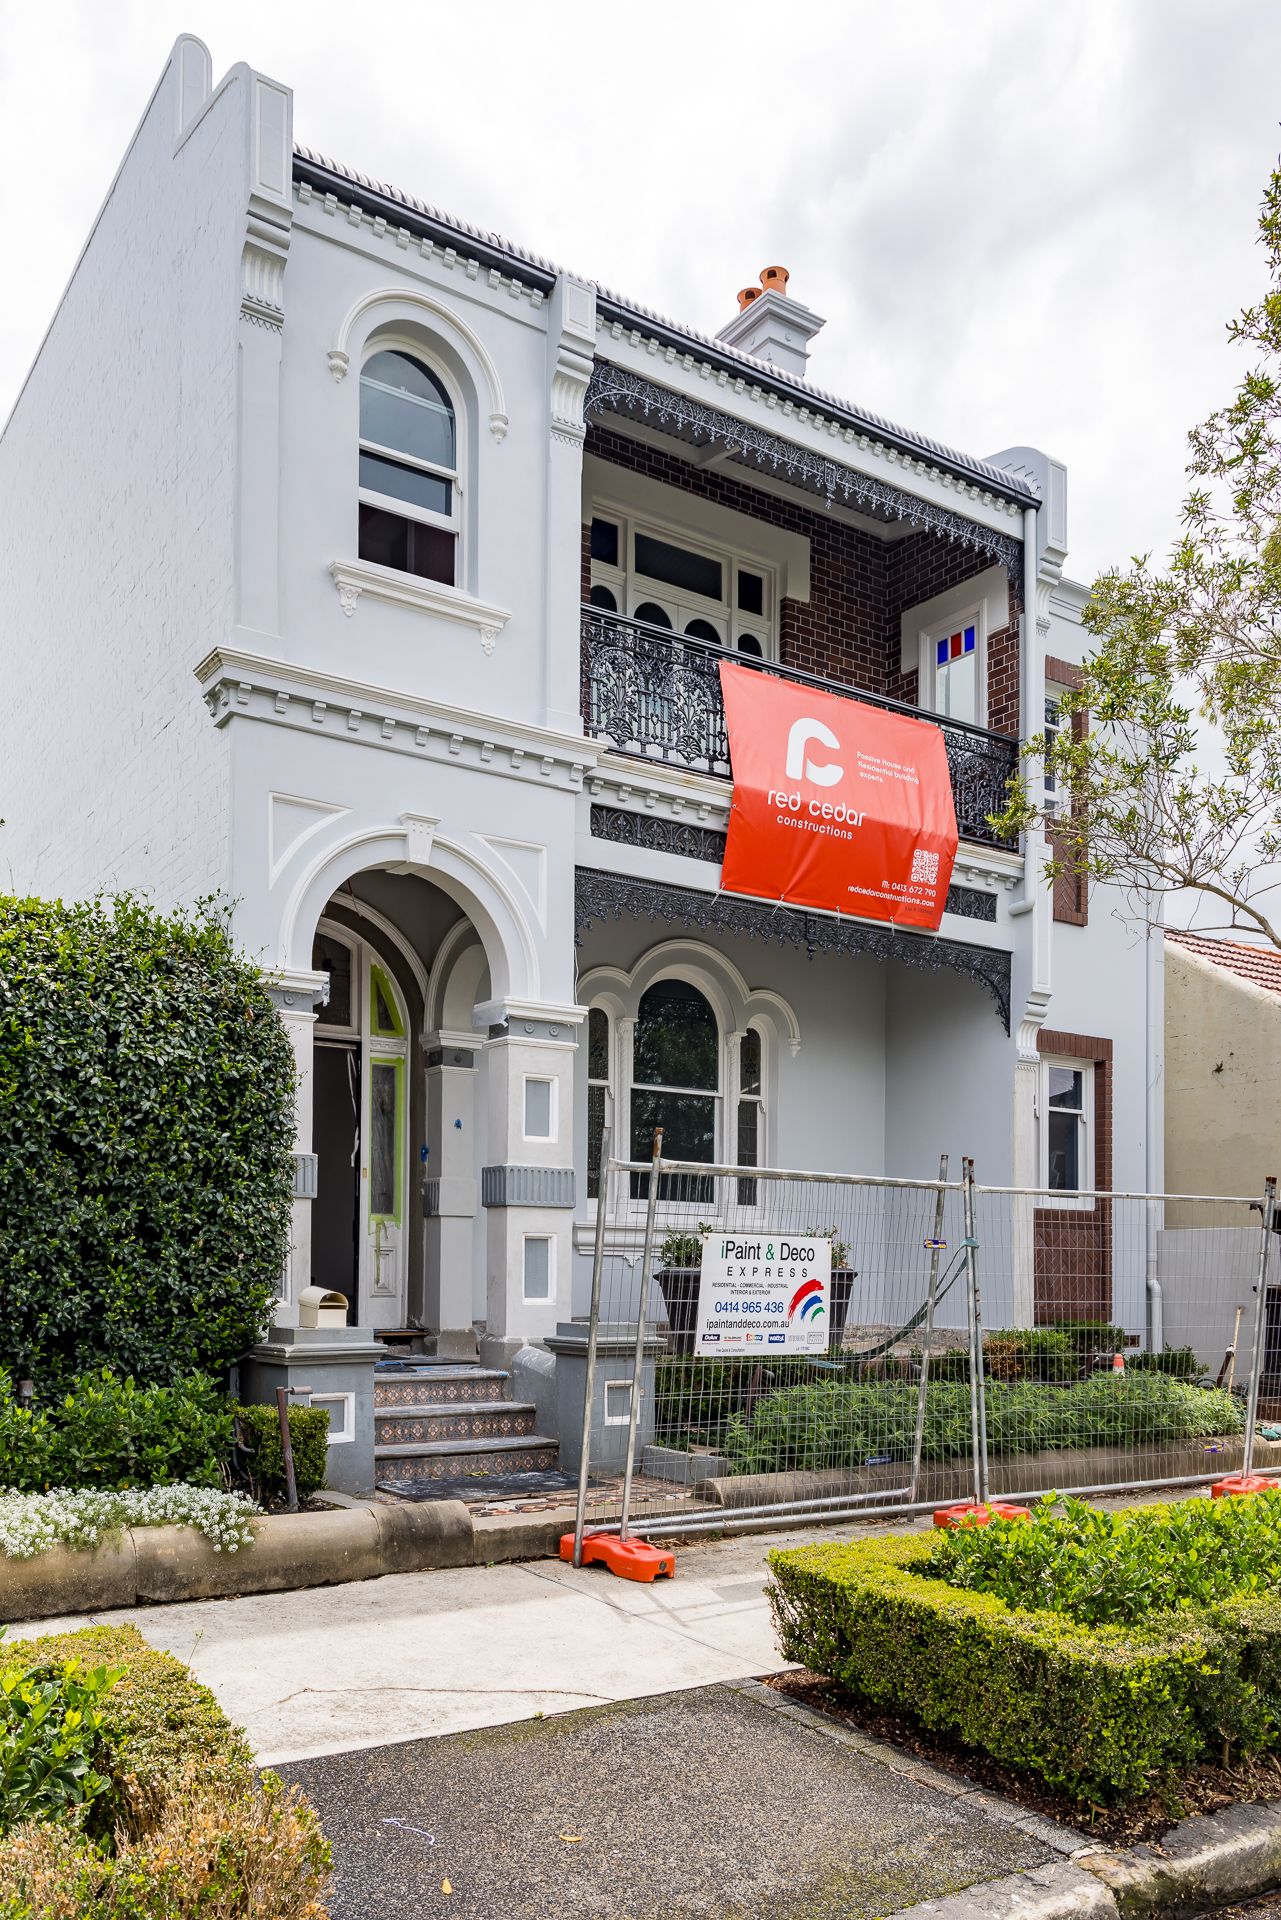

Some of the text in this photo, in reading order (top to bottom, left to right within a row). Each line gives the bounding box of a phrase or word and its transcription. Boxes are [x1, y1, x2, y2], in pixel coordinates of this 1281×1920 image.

[856, 751, 915, 773] Passive House and
[857, 760, 920, 785] Residential building
[859, 771, 884, 783] experts
[767, 788, 866, 827] red cedar
[776, 815, 853, 840] constructions
[847, 885, 935, 907] redcedarconstructions.com
[891, 883, 907, 892] 0413
[909, 886, 923, 895] 672
[924, 888, 936, 897] 790
[721, 1240, 815, 1262] iPaint & Deco
[727, 1266, 808, 1278] EXPRESS
[715, 1301, 784, 1313] 0414 965 436
[706, 1318, 790, 1331] ipaintanddeco.com.au
